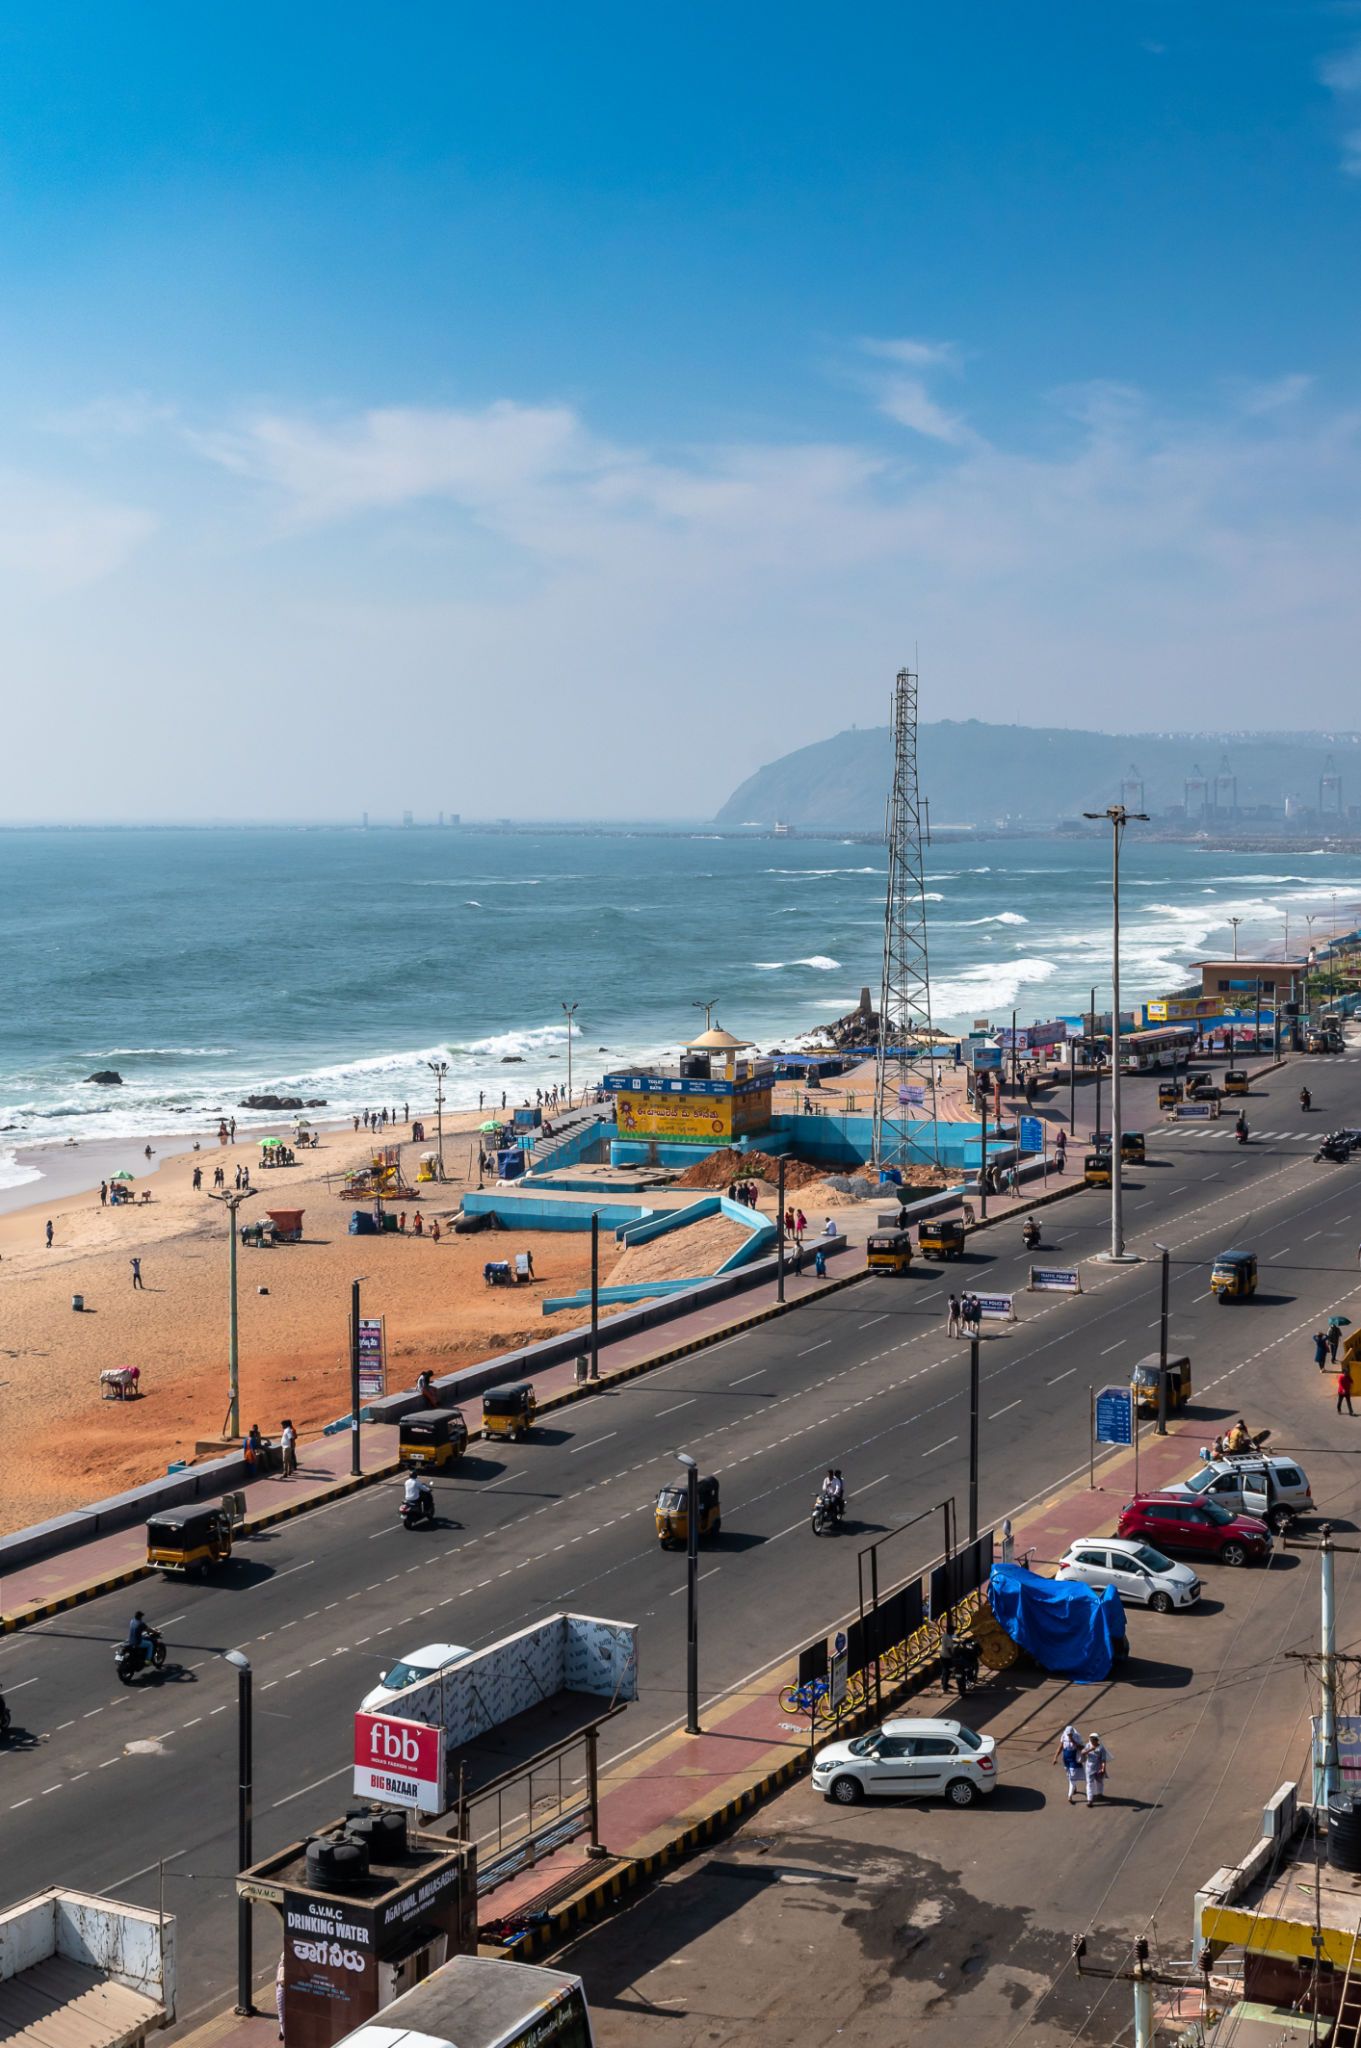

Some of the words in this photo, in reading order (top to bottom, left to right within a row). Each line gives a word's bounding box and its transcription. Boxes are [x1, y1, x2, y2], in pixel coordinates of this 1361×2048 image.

[370, 1722, 419, 1762] fbb
[370, 1774, 385, 1790] BIG
[385, 1778, 418, 1798] BAZAAR
[308, 1903, 343, 1920] G.V.M.C
[287, 1911, 335, 1936] DRINKING
[335, 1922, 370, 1944] WATER
